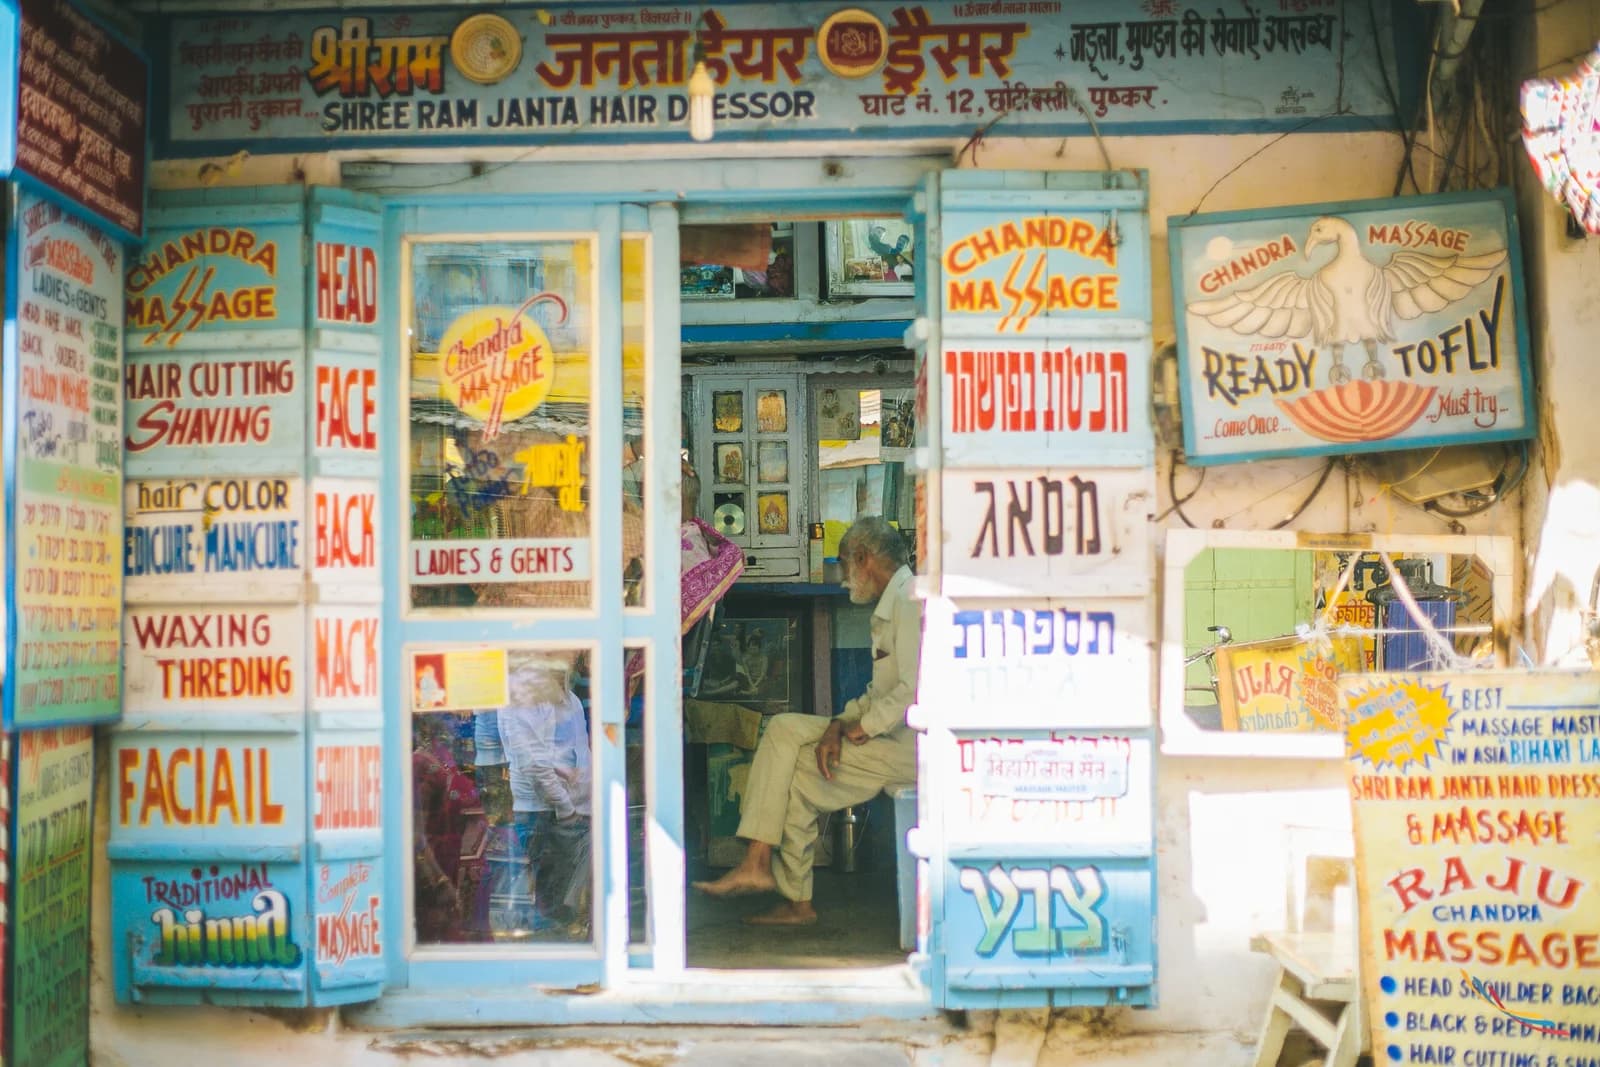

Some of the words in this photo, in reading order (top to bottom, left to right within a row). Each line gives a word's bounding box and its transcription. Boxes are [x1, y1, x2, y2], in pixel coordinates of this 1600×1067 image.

[536, 30, 692, 90] जनता
[697, 9, 814, 87] हेयर
[1180, 9, 1208, 56] की
[322, 101, 410, 132] SHREE
[417, 100, 478, 131] RAM
[487, 96, 578, 128] JANTA
[591, 95, 656, 125] HAIR
[668, 90, 815, 123] DESSOR
[859, 94, 907, 116] घाट
[943, 216, 1119, 276] CHANDRA
[1368, 219, 1471, 252] MASSAGE
[124, 227, 278, 294] CHANDRA
[316, 241, 378, 324] HEAD
[1199, 234, 1297, 295] CHANDRA
[32, 268, 71, 307] LADIES
[76, 286, 108, 321] GENTS
[124, 264, 278, 346] MASSAGE
[947, 258, 1120, 334] MASSAGE
[1392, 338, 1439, 378] TO
[1437, 274, 1506, 375] FLY
[124, 361, 183, 401] HAIR
[188, 358, 295, 399] CUTTING
[1201, 341, 1319, 408] READY
[126, 399, 272, 453] SHAVING
[316, 364, 378, 451] FACE
[136, 482, 199, 515] hair
[203, 480, 290, 512] COLOR
[124, 525, 196, 577] EDICURE
[204, 520, 300, 574] MANICURE
[315, 491, 376, 569] BACK
[415, 547, 482, 576] LADIES
[489, 547, 503, 574] &
[510, 547, 574, 574] GENTS
[132, 613, 272, 651] WAXING
[157, 656, 294, 701] THREDING
[315, 617, 379, 699] NACK
[1461, 687, 1504, 711] BEST
[1461, 716, 1543, 738] MASSAGE
[1451, 745, 1467, 766] IN
[1473, 744, 1510, 766] ASIA
[1509, 737, 1571, 765] BIHARI
[118, 745, 287, 828] FACIAIL
[1351, 774, 1390, 802] SHRI
[1394, 774, 1435, 801] RAM
[1440, 774, 1495, 801] JANTA
[1497, 773, 1542, 800] HAIR
[1431, 805, 1569, 847] MASSAGE
[1387, 856, 1586, 915] RAJU
[317, 895, 382, 966] MASSAGE
[1432, 903, 1544, 924] CHANDRA
[1383, 927, 1600, 970] MASSAGE
[1404, 975, 1453, 998] HEAD
[1562, 983, 1600, 1008] BAC
[1406, 1010, 1467, 1035] BLACK
[1474, 1014, 1488, 1035] &
[1492, 1016, 1534, 1039] RED
[1410, 1043, 1456, 1067] HAIR
[1464, 1049, 1541, 1067] CUTTING
